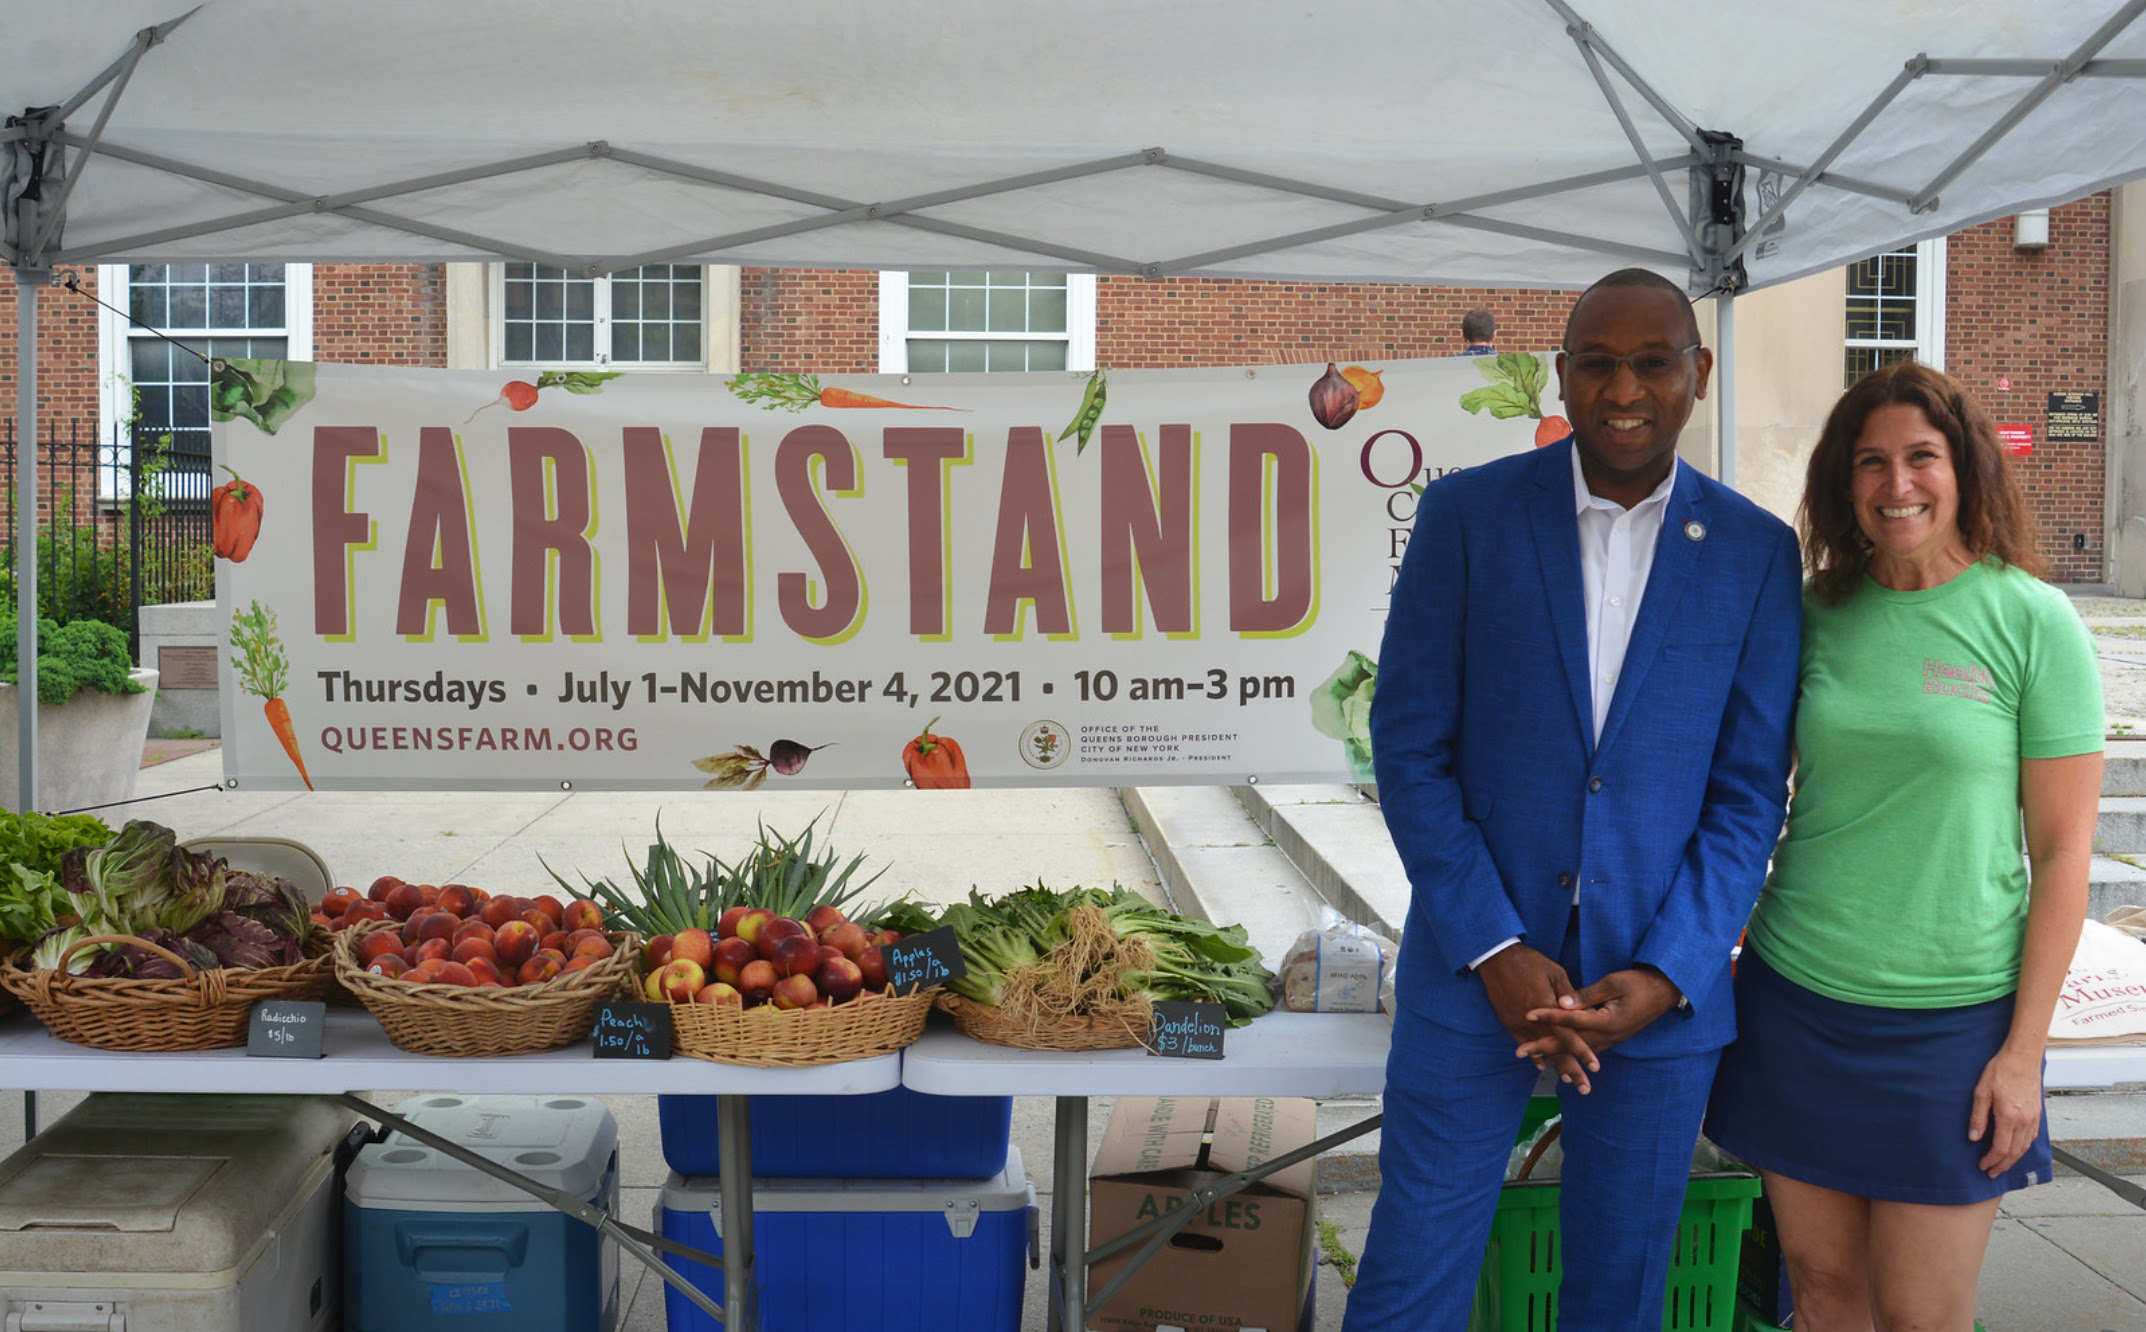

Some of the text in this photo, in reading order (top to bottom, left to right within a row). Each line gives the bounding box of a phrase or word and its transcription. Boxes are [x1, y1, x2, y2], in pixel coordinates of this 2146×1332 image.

[312, 422, 1321, 645] FARMSTAND
[317, 670, 506, 710] Thursdays
[558, 670, 632, 711] July
[882, 671, 919, 709] 4,
[930, 671, 1020, 703] 2021
[1074, 669, 1118, 702] 10
[1239, 675, 1295, 707] pm
[1922, 677, 1992, 704] Bucks
[1080, 725, 1159, 733] OFFICE OF THE
[1080, 733, 1238, 744] QUEENS BOROUGH PRESIDENT
[320, 726, 639, 754] QUEENSFARM.ORG
[1080, 745, 1104, 753] CITY
[1108, 745, 1121, 753] OF
[1152, 744, 1180, 752] YORK
[892, 946, 932, 968] Apples
[261, 1008, 306, 1023] Radicchio
[1153, 1011, 1221, 1036] Dandelion
[2072, 1006, 2126, 1025] Farmed
[1136, 1149, 1163, 1169] CARE
[1136, 1194, 1262, 1232] APLES
[1140, 1308, 1195, 1324] PRODUCE
[1199, 1314, 1216, 1325] OF
[1219, 1316, 1242, 1326] USA
